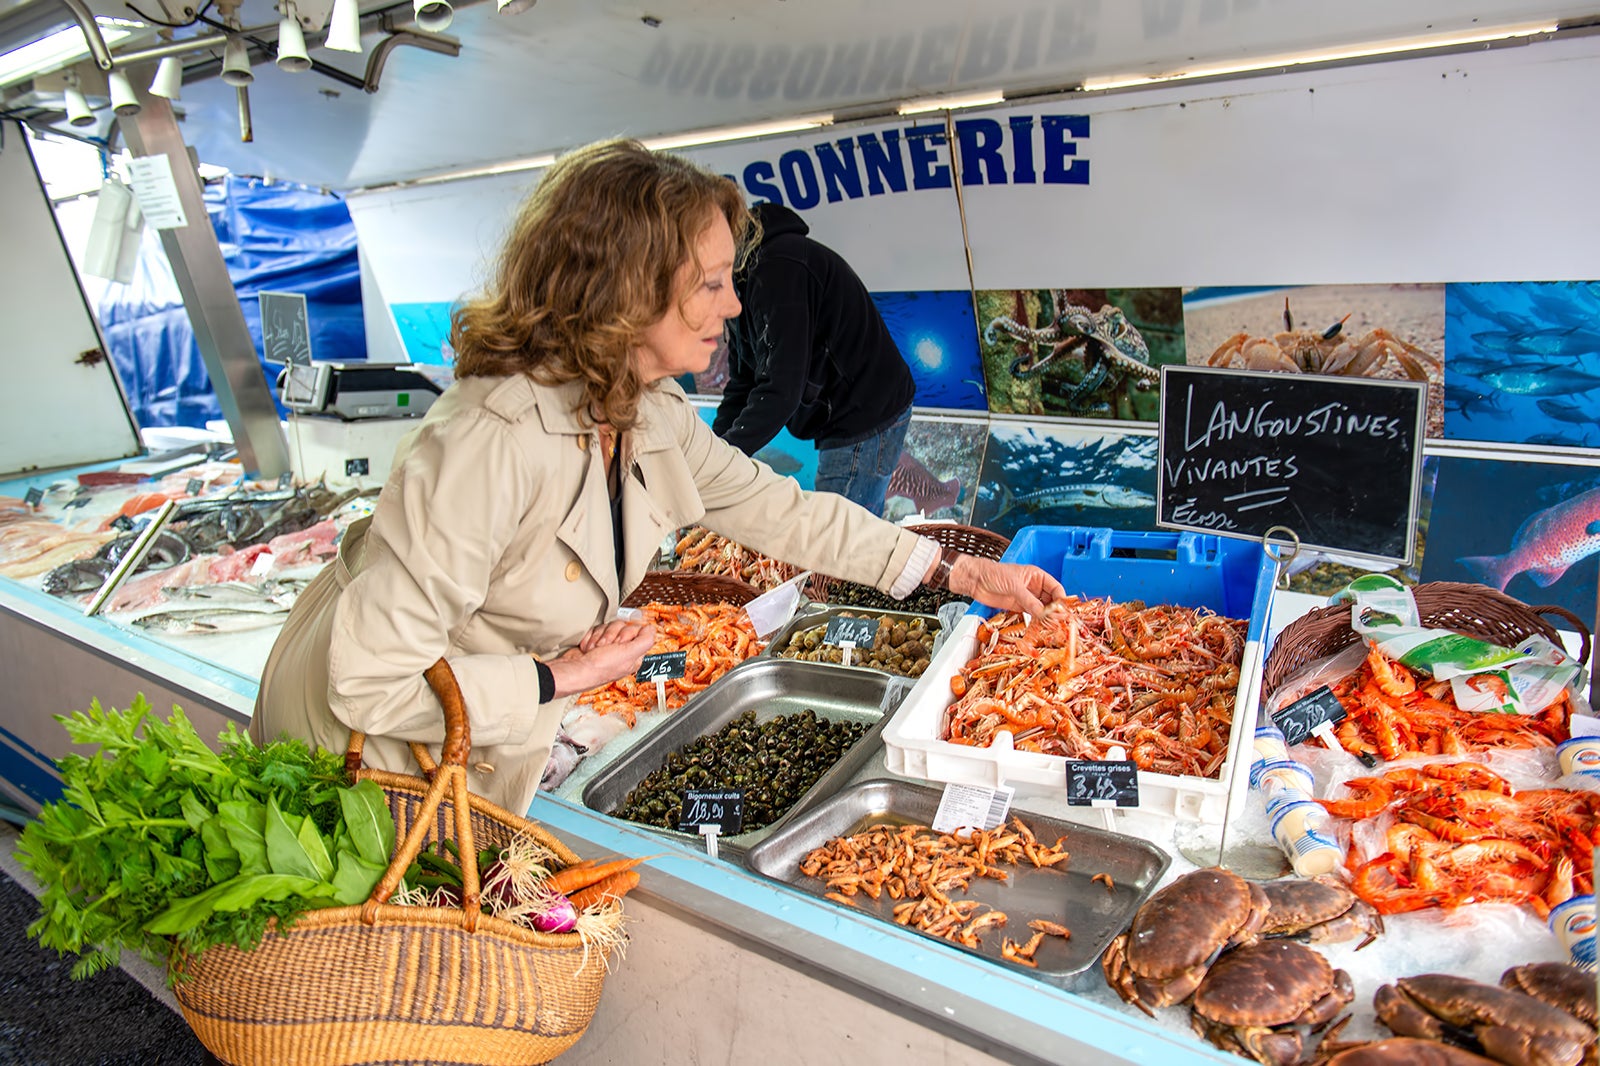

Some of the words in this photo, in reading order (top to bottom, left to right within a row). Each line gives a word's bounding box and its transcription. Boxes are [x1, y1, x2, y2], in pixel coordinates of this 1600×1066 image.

[722, 115, 1090, 210] SONNERIE
[1071, 764, 1106, 772] Crevettes
[1107, 764, 1131, 774] grises
